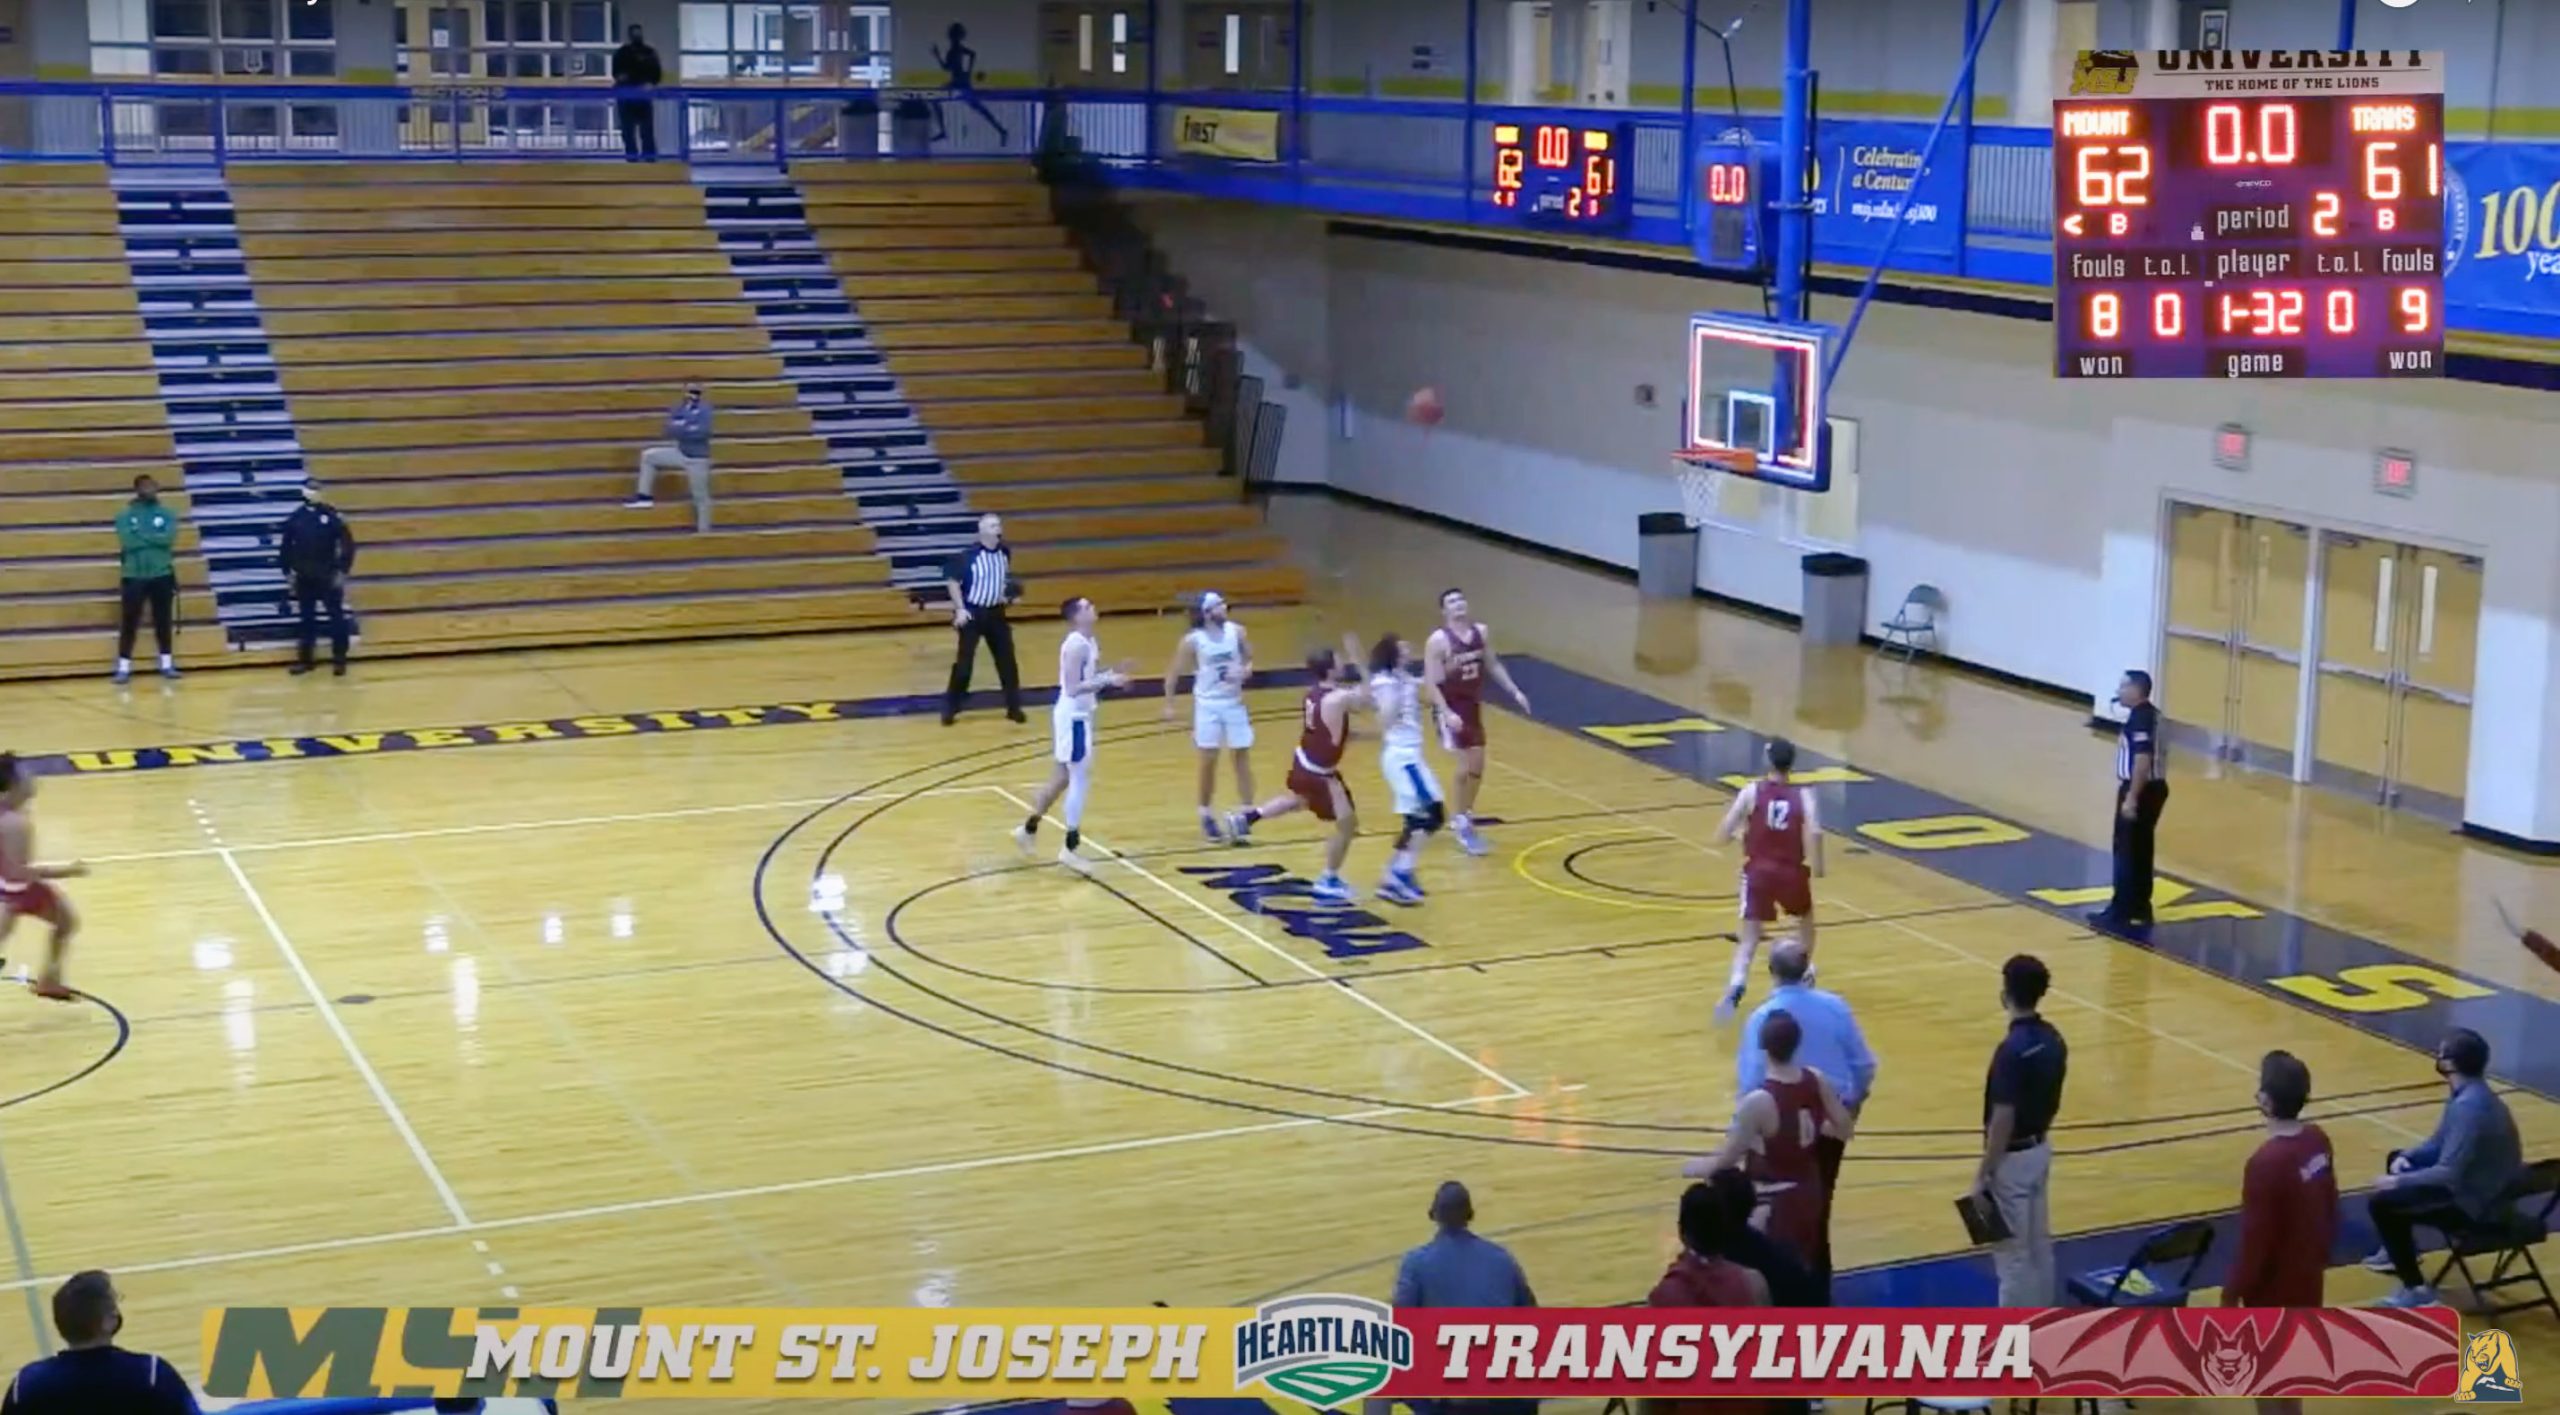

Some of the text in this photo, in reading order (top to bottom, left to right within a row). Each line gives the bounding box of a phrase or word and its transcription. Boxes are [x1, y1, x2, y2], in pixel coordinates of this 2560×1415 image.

[2205, 77, 2380, 91] THE HOME OF THE LIONS
[2062, 110, 2131, 137] MOUNT
[2207, 104, 2296, 164] 0.0
[2351, 105, 2416, 132] TRANS
[1709, 164, 1746, 204] 0.0
[2078, 146, 2150, 206] 62
[2366, 141, 2438, 200] 61
[2110, 212, 2128, 235] B
[2217, 204, 2289, 236] period
[2313, 192, 2339, 236] 2
[2377, 207, 2396, 231] B
[2217, 248, 2291, 280] player
[2091, 292, 2119, 338] 8
[2154, 292, 2182, 337] 0
[2327, 290, 2354, 333] 0
[2400, 288, 2428, 333] 9
[2080, 356, 2123, 377] won
[2228, 353, 2284, 379] game
[2389, 350, 2432, 370] won
[67, 702, 841, 772] UNIVERSITY
[1768, 799, 1790, 831] 12
[1175, 862, 1433, 959] NCAA
